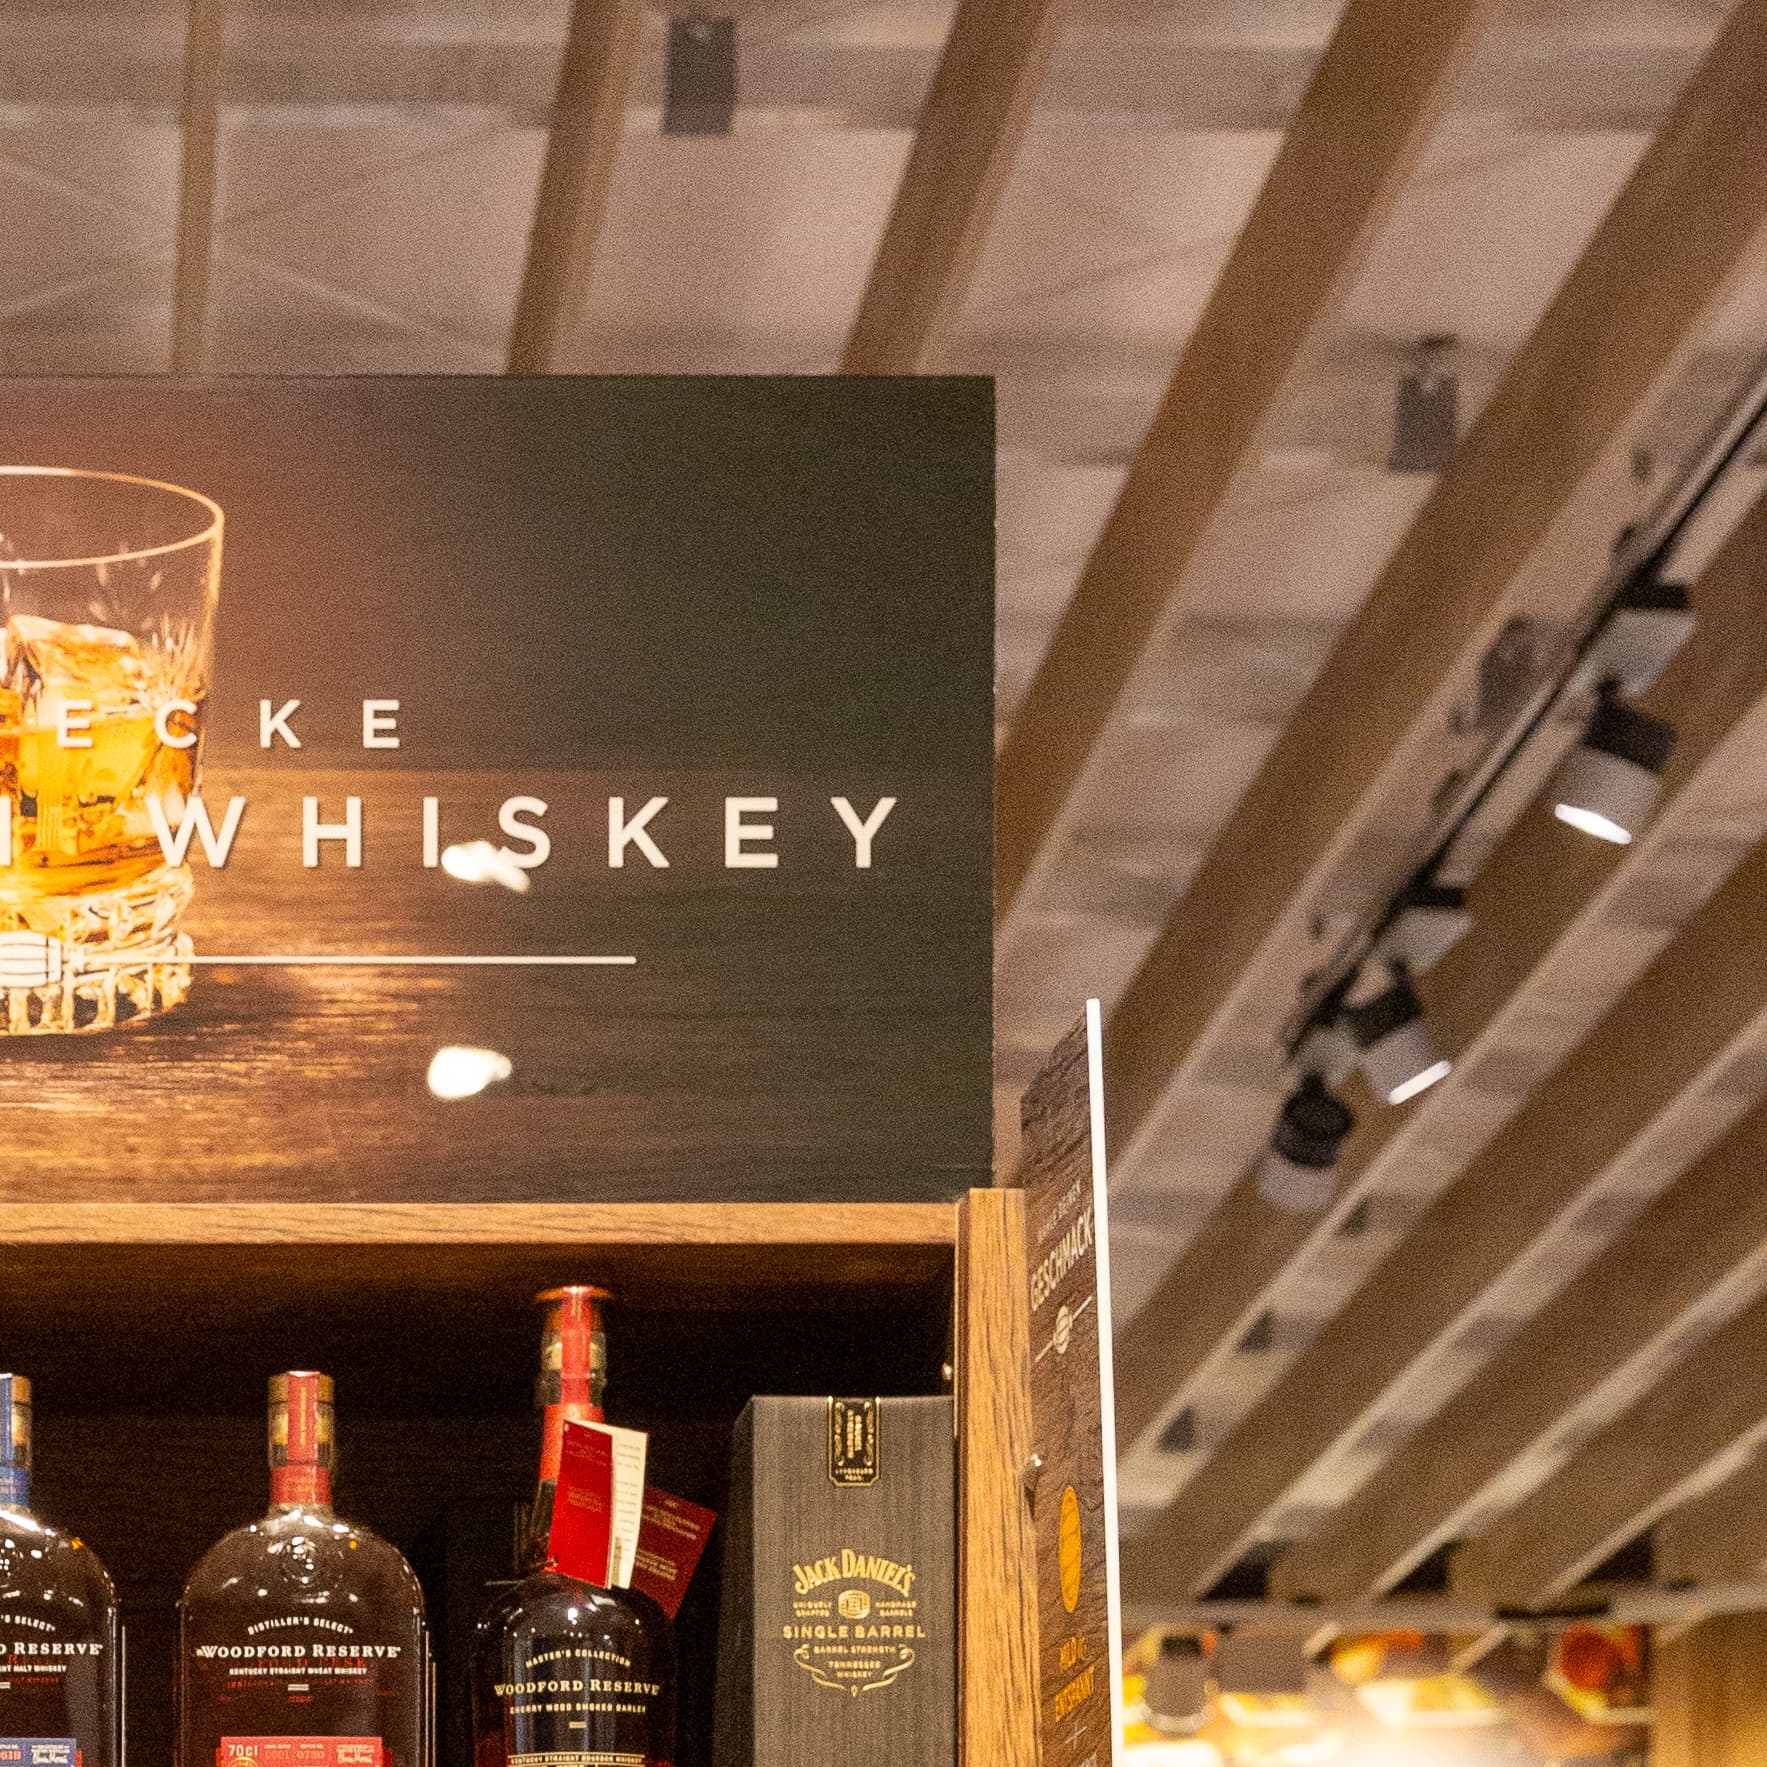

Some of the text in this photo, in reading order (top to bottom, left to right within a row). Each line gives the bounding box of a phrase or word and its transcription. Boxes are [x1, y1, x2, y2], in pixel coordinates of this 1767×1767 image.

[144, 793, 901, 872] WHISKEY
[793, 1549, 916, 1596] JACK DANIEL'S
[782, 1625, 926, 1639] SINGLE BARREL
[13, 1642, 100, 1657] RESERVE
[201, 1644, 398, 1660] WOODFORD RESERVE
[494, 1680, 660, 1696] WOODFORD RESERVE
